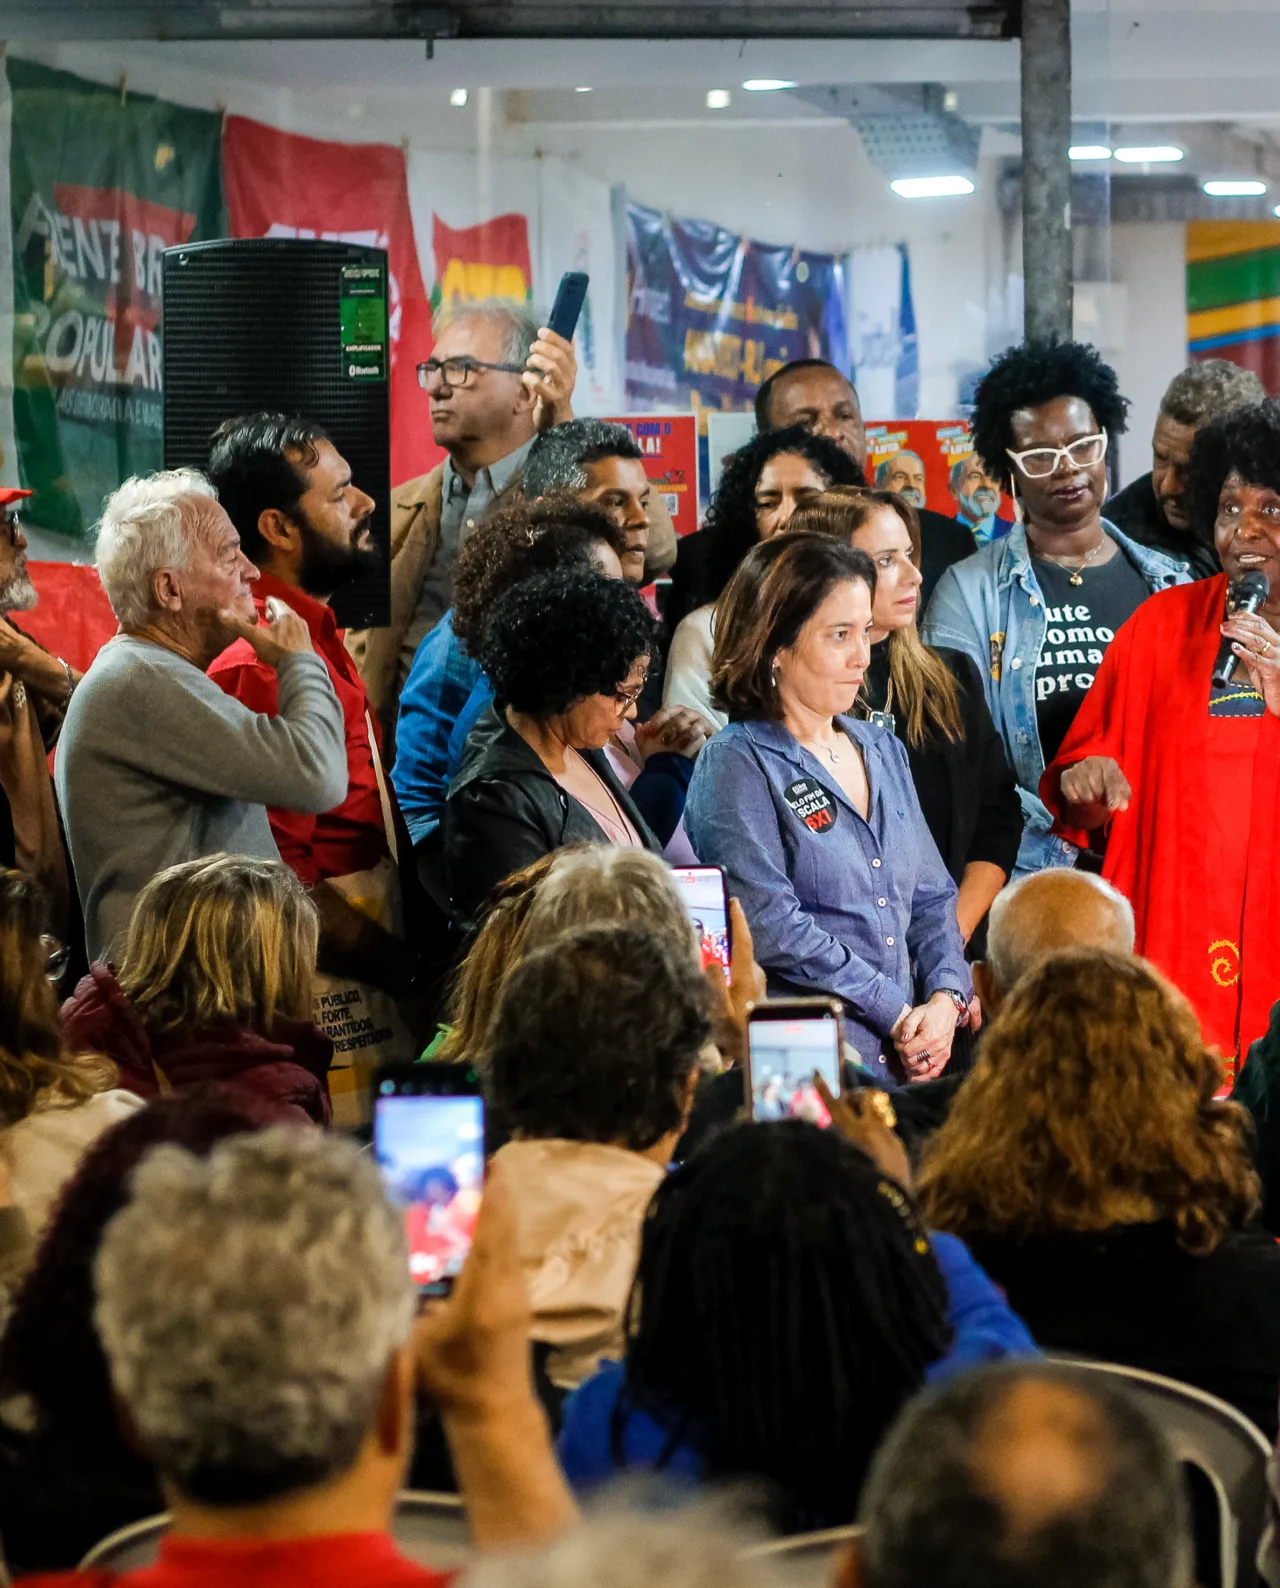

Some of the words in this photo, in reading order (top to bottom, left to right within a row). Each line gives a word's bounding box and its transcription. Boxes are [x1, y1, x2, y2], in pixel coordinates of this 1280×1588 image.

[638, 437, 661, 453] LA!
[1045, 604, 1092, 622] ute
[1046, 627, 1115, 645] omo
[1036, 648, 1103, 667] uma
[1036, 673, 1095, 700] pro
[793, 798, 805, 809] ELO
[804, 792, 816, 803] FIM
[814, 789, 825, 798] DA
[797, 796, 831, 818] SCALA
